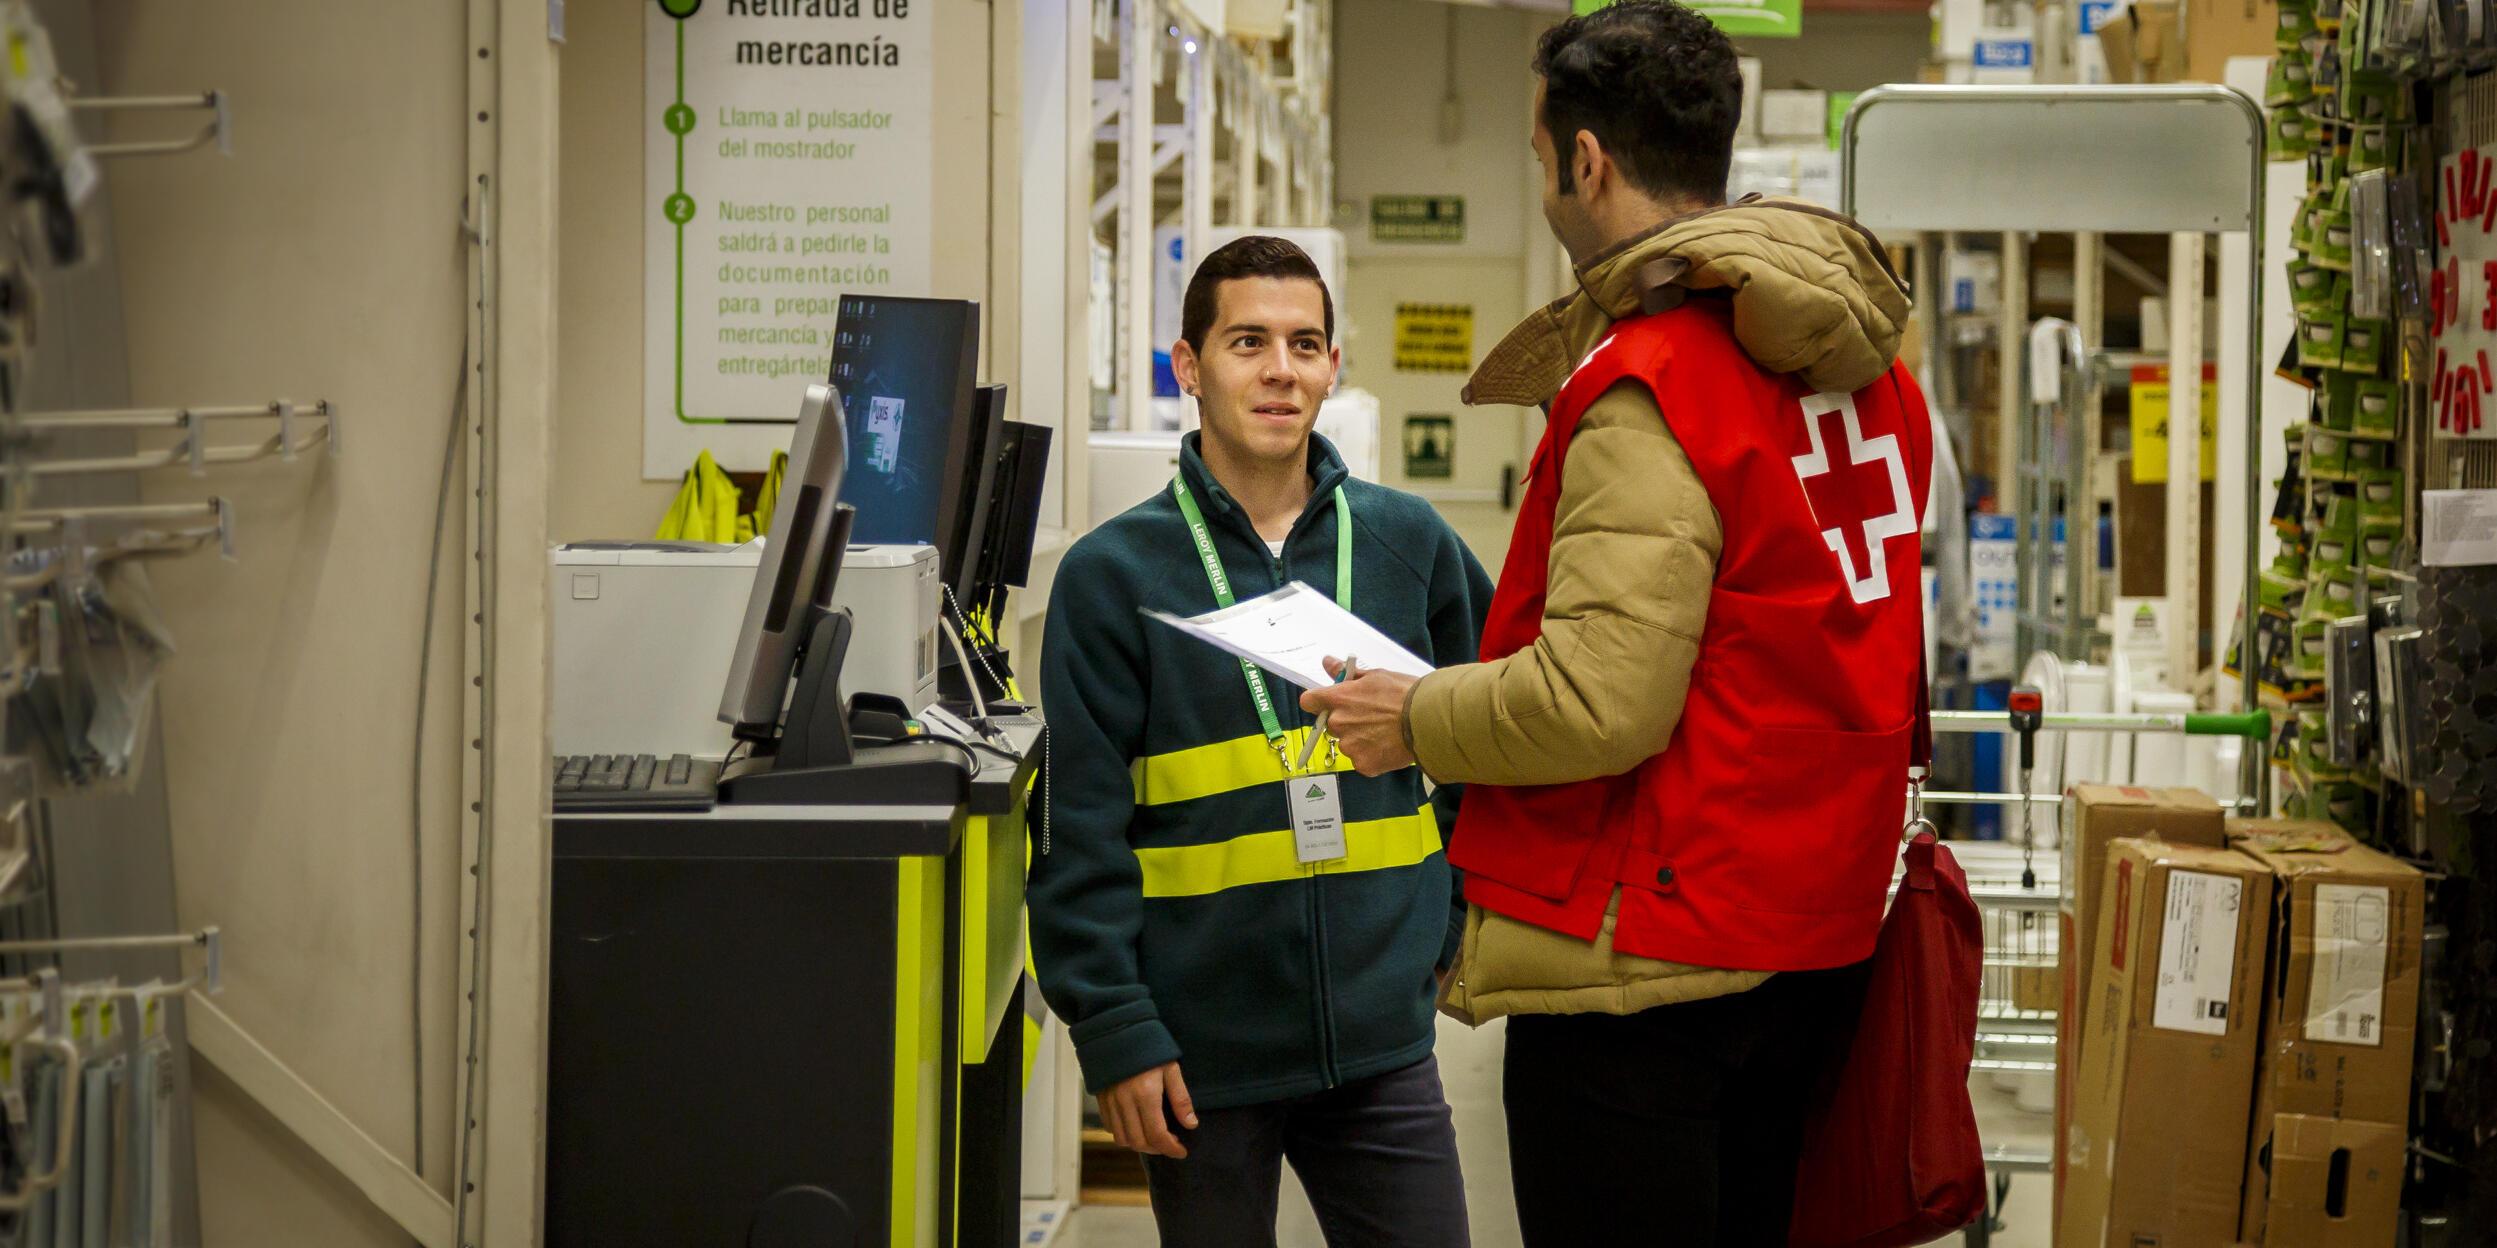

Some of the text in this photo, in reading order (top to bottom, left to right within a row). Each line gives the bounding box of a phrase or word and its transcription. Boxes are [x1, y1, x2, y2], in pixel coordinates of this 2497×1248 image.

[736, 35, 899, 67] mercancía
[675, 106, 893, 131] 1 Llama al pulsador
[718, 138, 856, 160] del mostrador
[675, 200, 891, 226] 2 Nuestro personal
[718, 232, 890, 257] saldrá a pedirle la
[717, 262, 891, 285] documentación
[718, 296, 761, 316] para
[718, 324, 818, 345] mercancía
[1193, 522, 1228, 596] LEROY MERLIN
[1248, 669, 1270, 712] MERLIN
